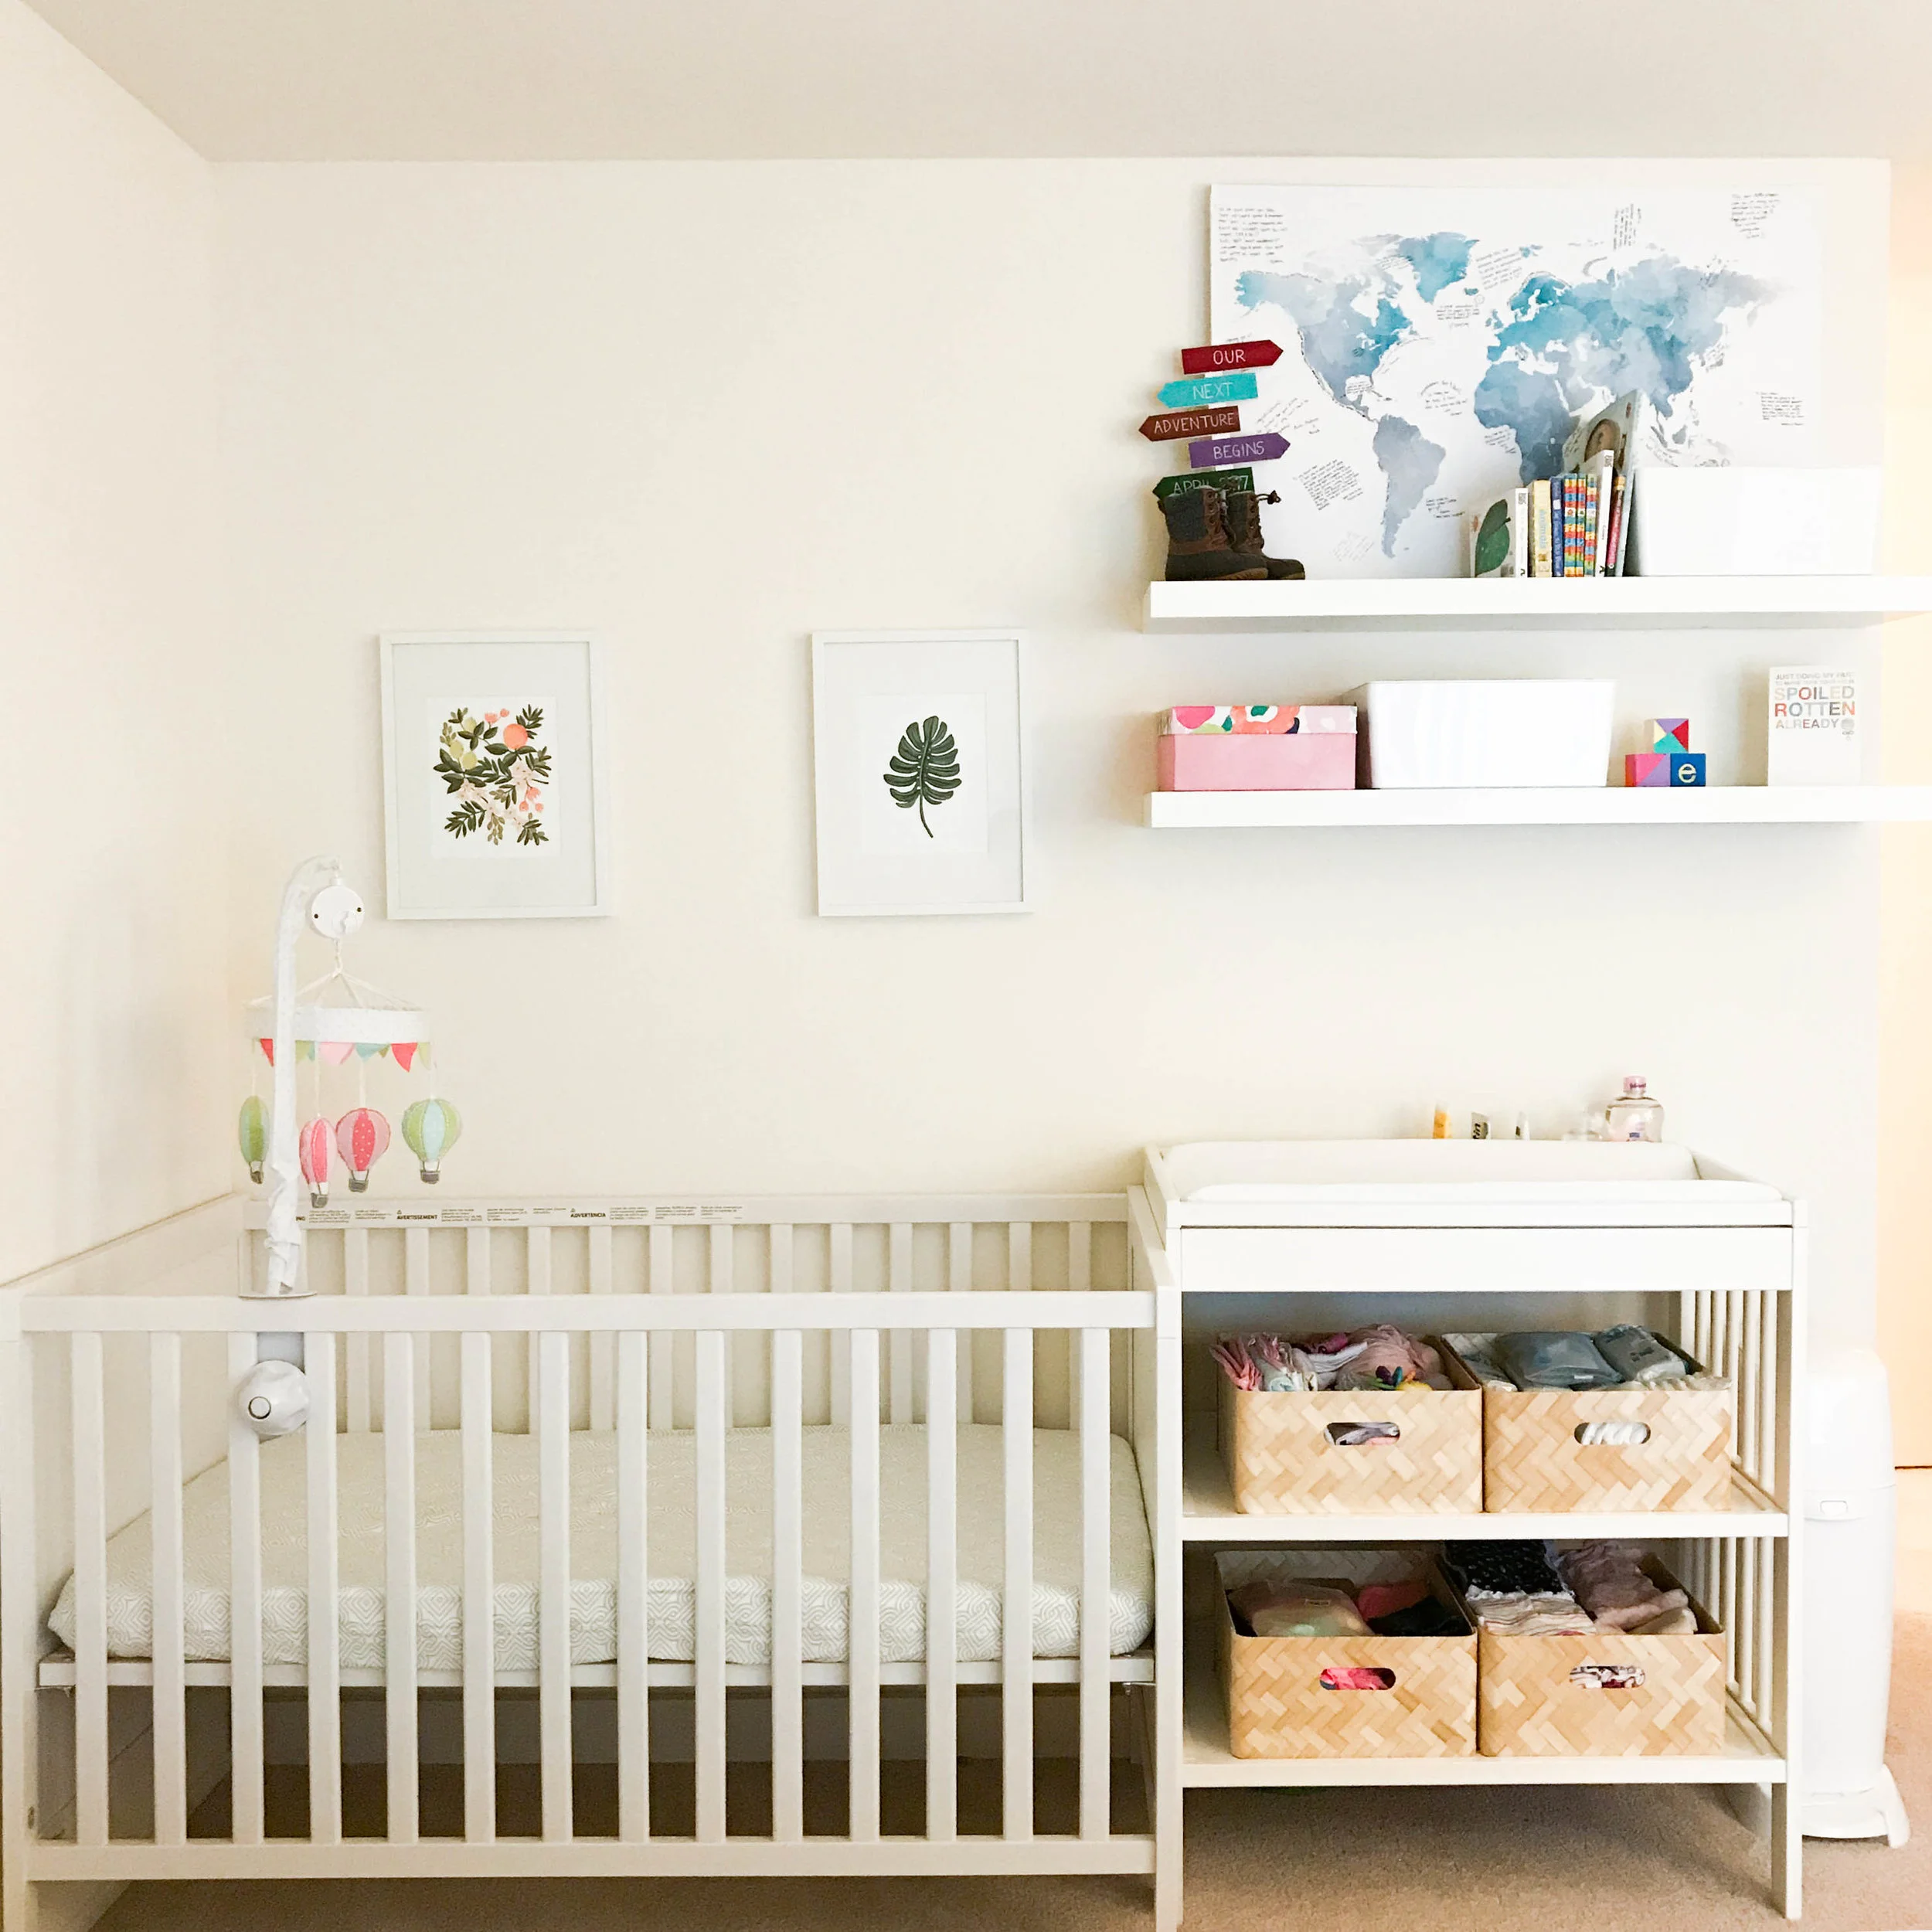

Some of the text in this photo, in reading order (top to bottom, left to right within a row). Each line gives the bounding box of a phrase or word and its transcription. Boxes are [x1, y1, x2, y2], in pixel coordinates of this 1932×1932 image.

[1213, 349, 1247, 366] OUR
[1192, 382, 1234, 400] NEXT
[1154, 412, 1236, 434] ADVENTURE
[1213, 440, 1265, 460] BEGINS
[1774, 685, 1855, 701] SPOILED
[1774, 701, 1855, 717] ROTTEN
[1775, 718, 1839, 730] ALREADY
[1678, 763, 1697, 784] e
